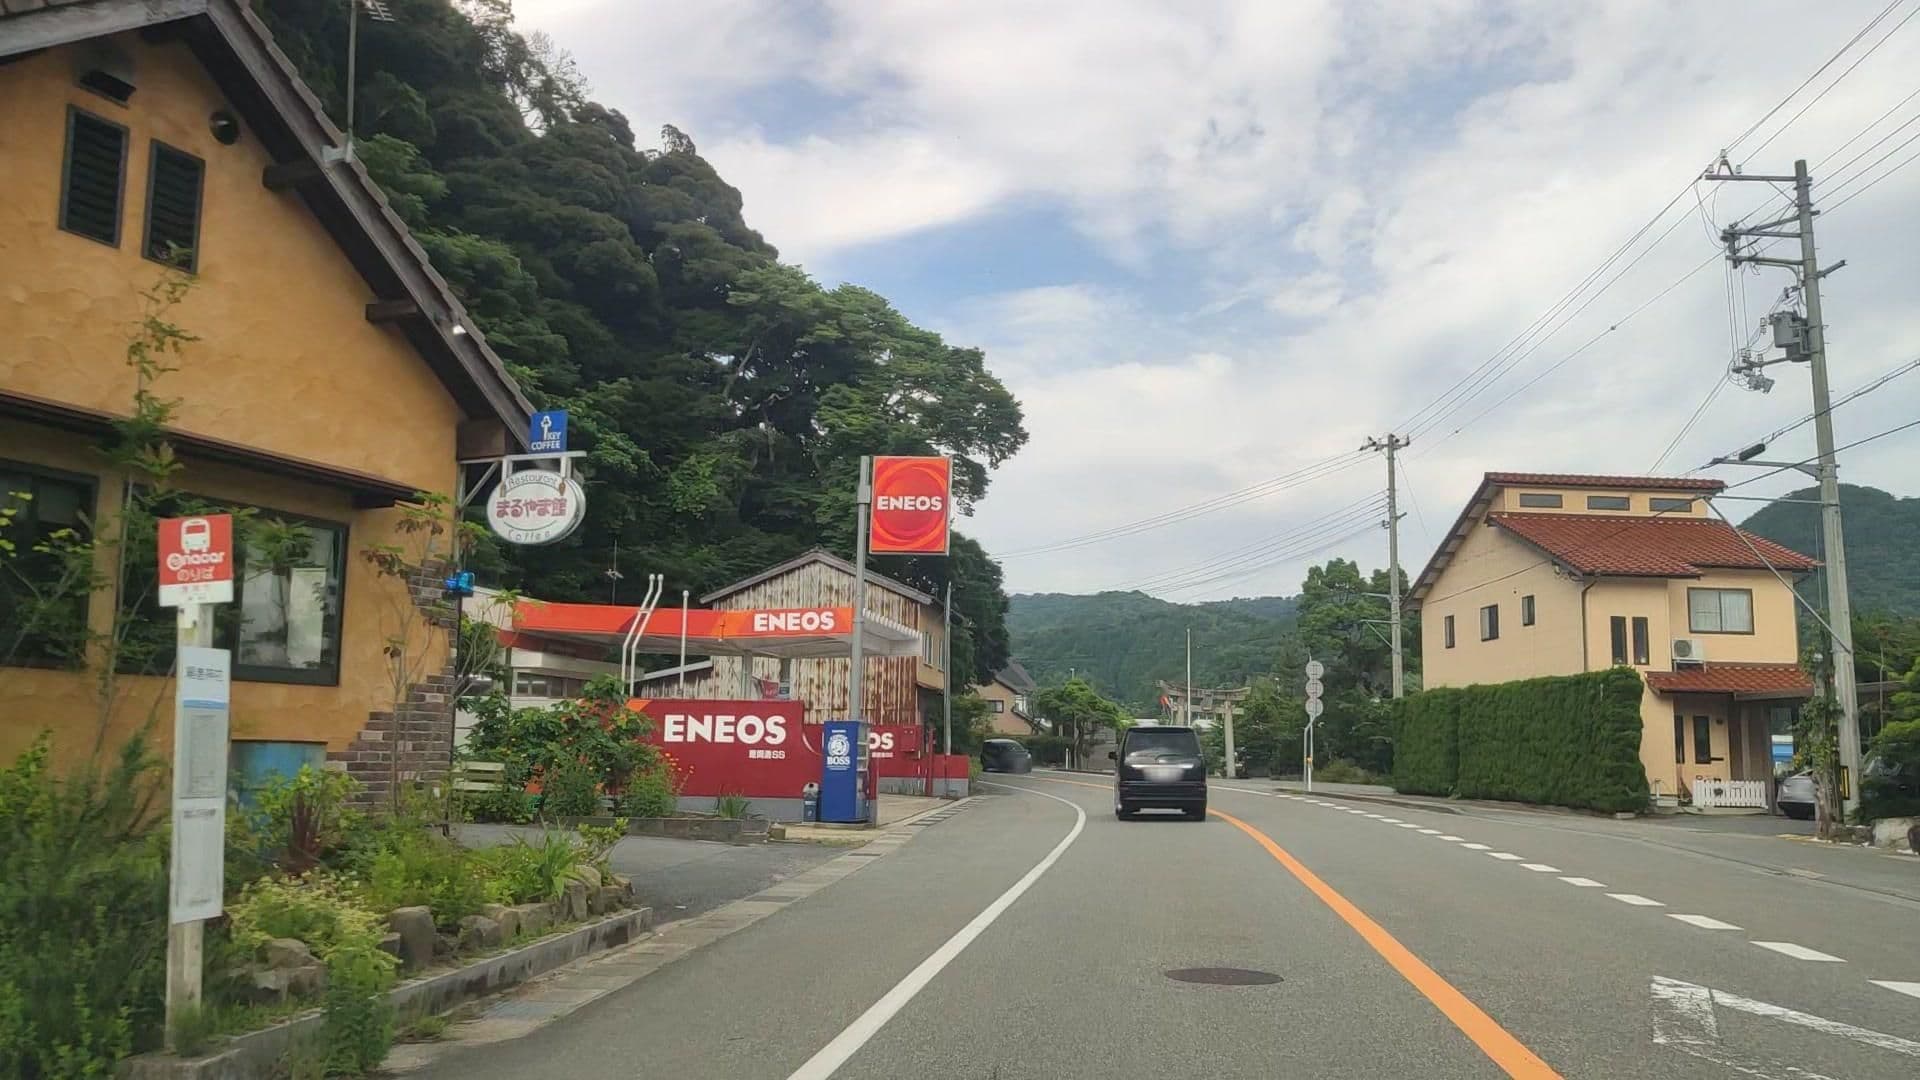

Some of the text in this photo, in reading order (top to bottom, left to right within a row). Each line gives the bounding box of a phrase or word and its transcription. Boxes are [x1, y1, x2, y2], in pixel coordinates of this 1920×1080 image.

[547, 431, 562, 441] KEY
[531, 440, 561, 450] COFFEE
[496, 498, 568, 519] まるやま館
[877, 496, 942, 511] ENEOS
[754, 611, 835, 632] ENEOS
[663, 714, 786, 745] ENEOS
[826, 755, 851, 766] BOSS
